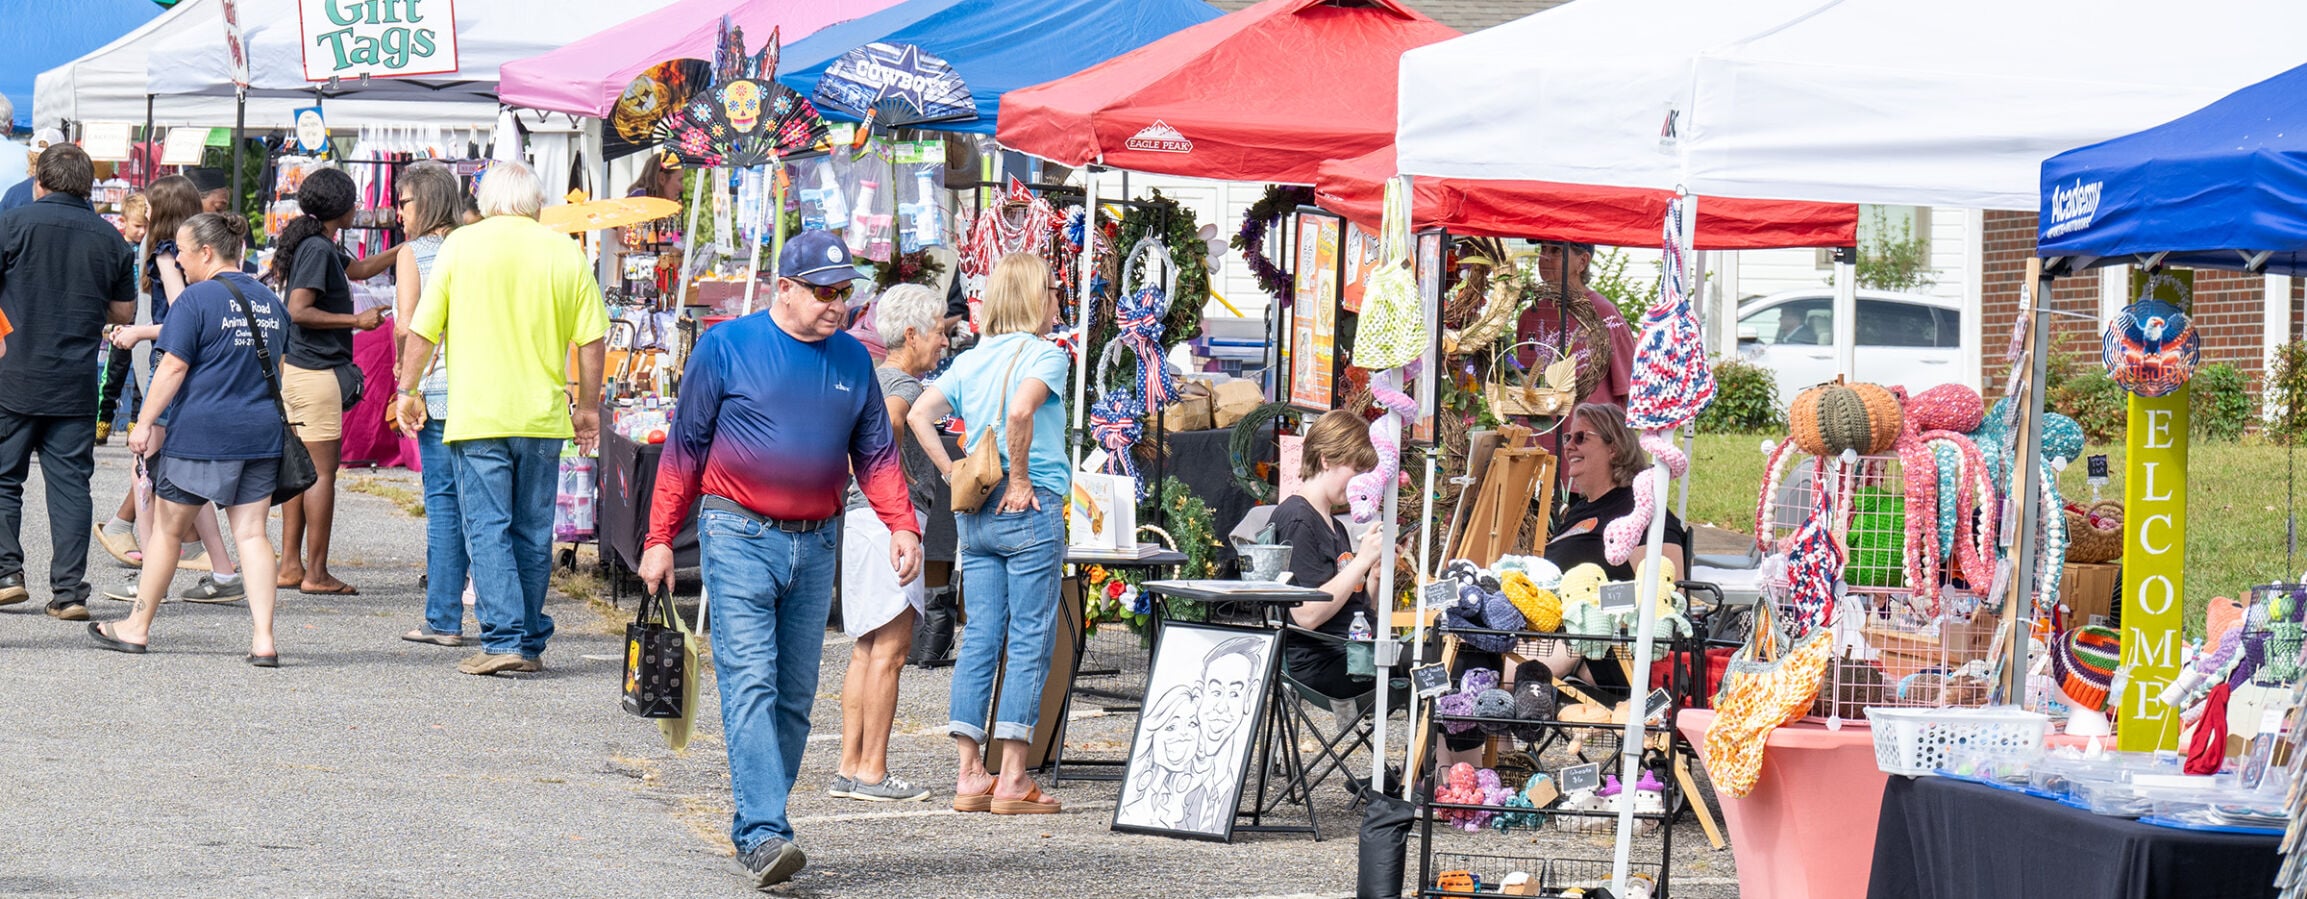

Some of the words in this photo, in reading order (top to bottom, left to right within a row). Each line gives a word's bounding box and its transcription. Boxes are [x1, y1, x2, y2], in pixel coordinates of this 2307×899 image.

[317, 27, 436, 71] Tags
[856, 60, 951, 98] COWBOYS
[1130, 140, 1160, 149] EAGLE
[1162, 141, 1189, 151] PEAK
[2051, 177, 2103, 224] Academy
[221, 316, 249, 330] Animal
[253, 314, 280, 331] ospital
[250, 300, 271, 314] Road
[2130, 408, 2176, 720] ELCOME
